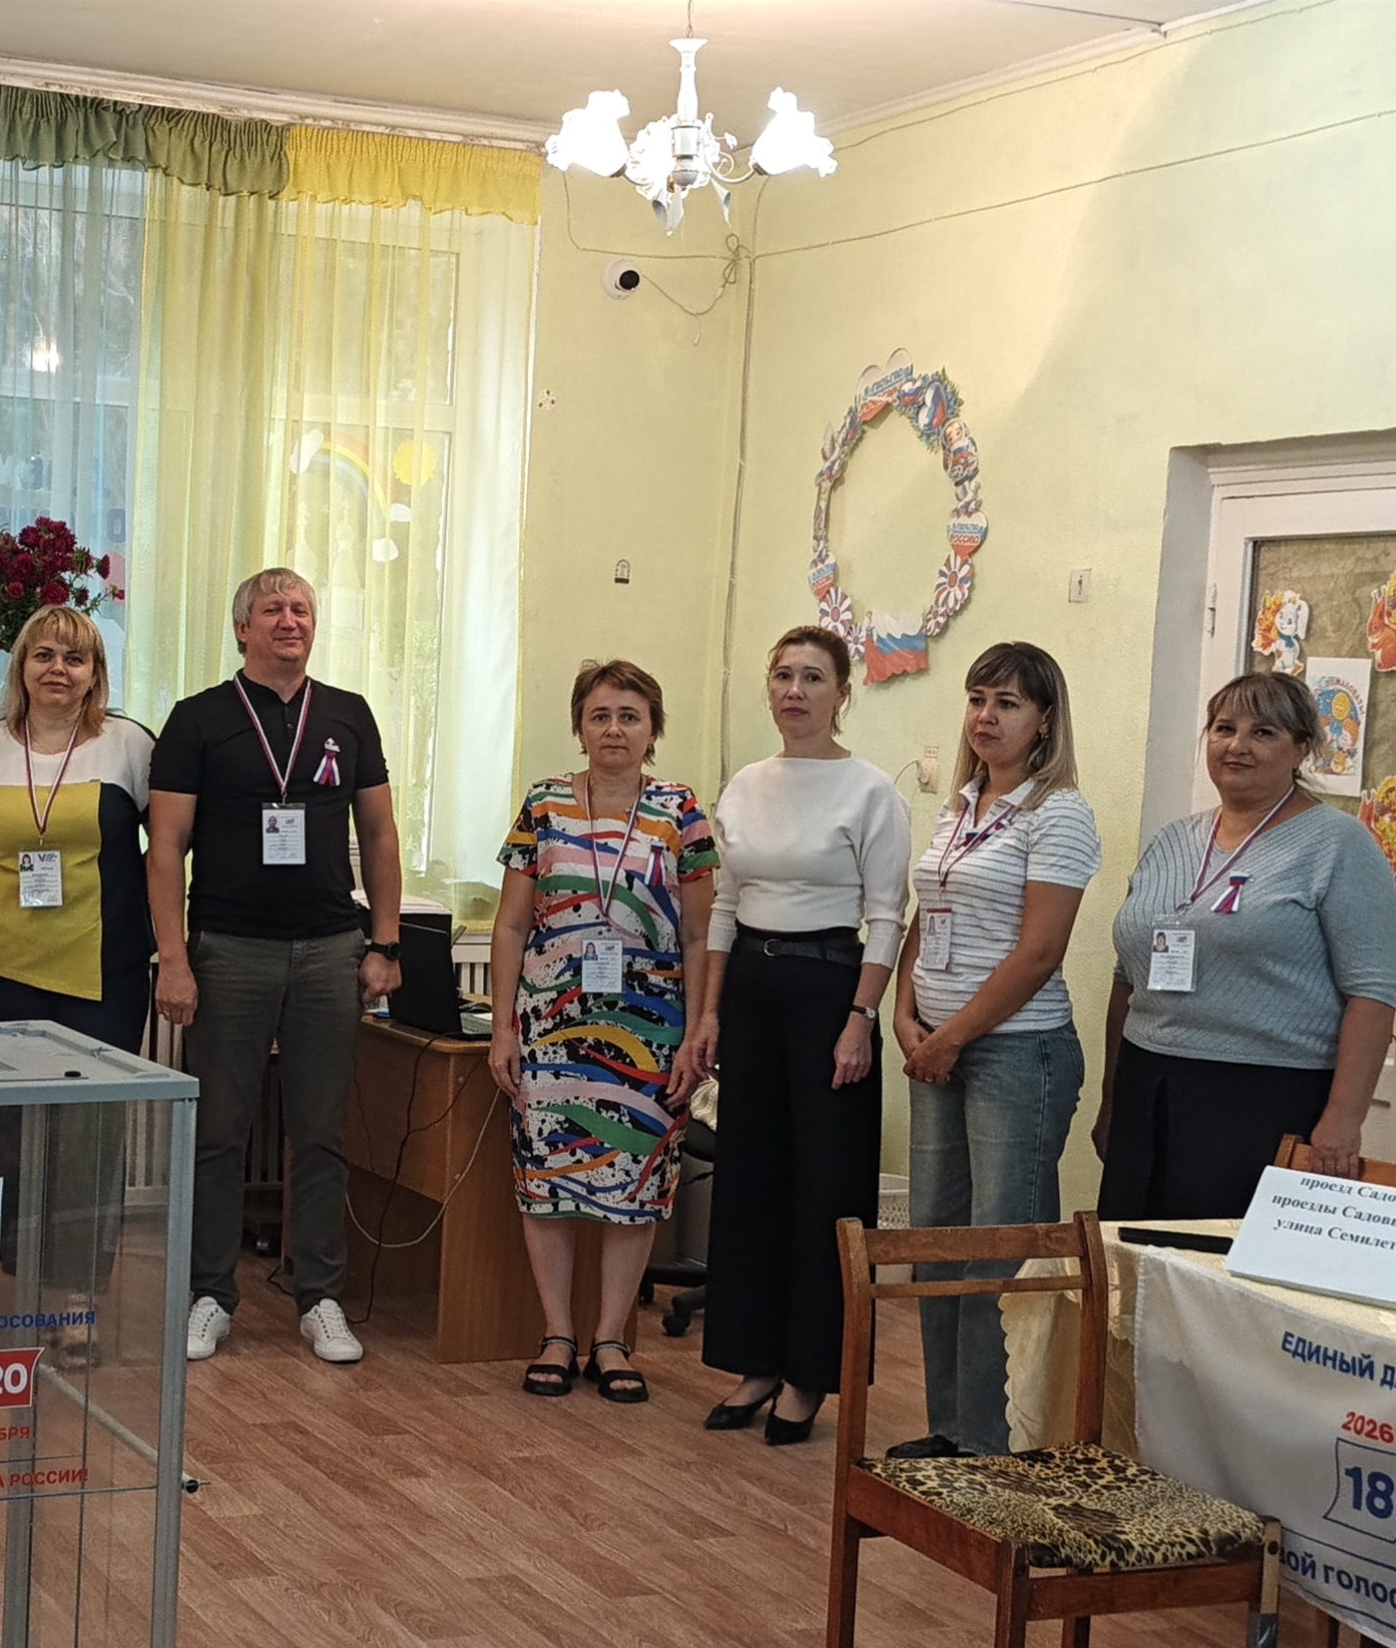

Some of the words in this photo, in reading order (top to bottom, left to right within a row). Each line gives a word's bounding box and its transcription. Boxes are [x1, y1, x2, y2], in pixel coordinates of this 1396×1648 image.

[1300, 1177, 1353, 1195] проезд
[1272, 1195, 1338, 1215] проезды
[1273, 1218, 1323, 1235] улица
[1281, 1331, 1374, 1381] ЕДИНЫЙ
[1341, 1411, 1394, 1444] 2026
[10, 1468, 88, 1486] РОССИИ!
[1344, 1466, 1394, 1519] 18
